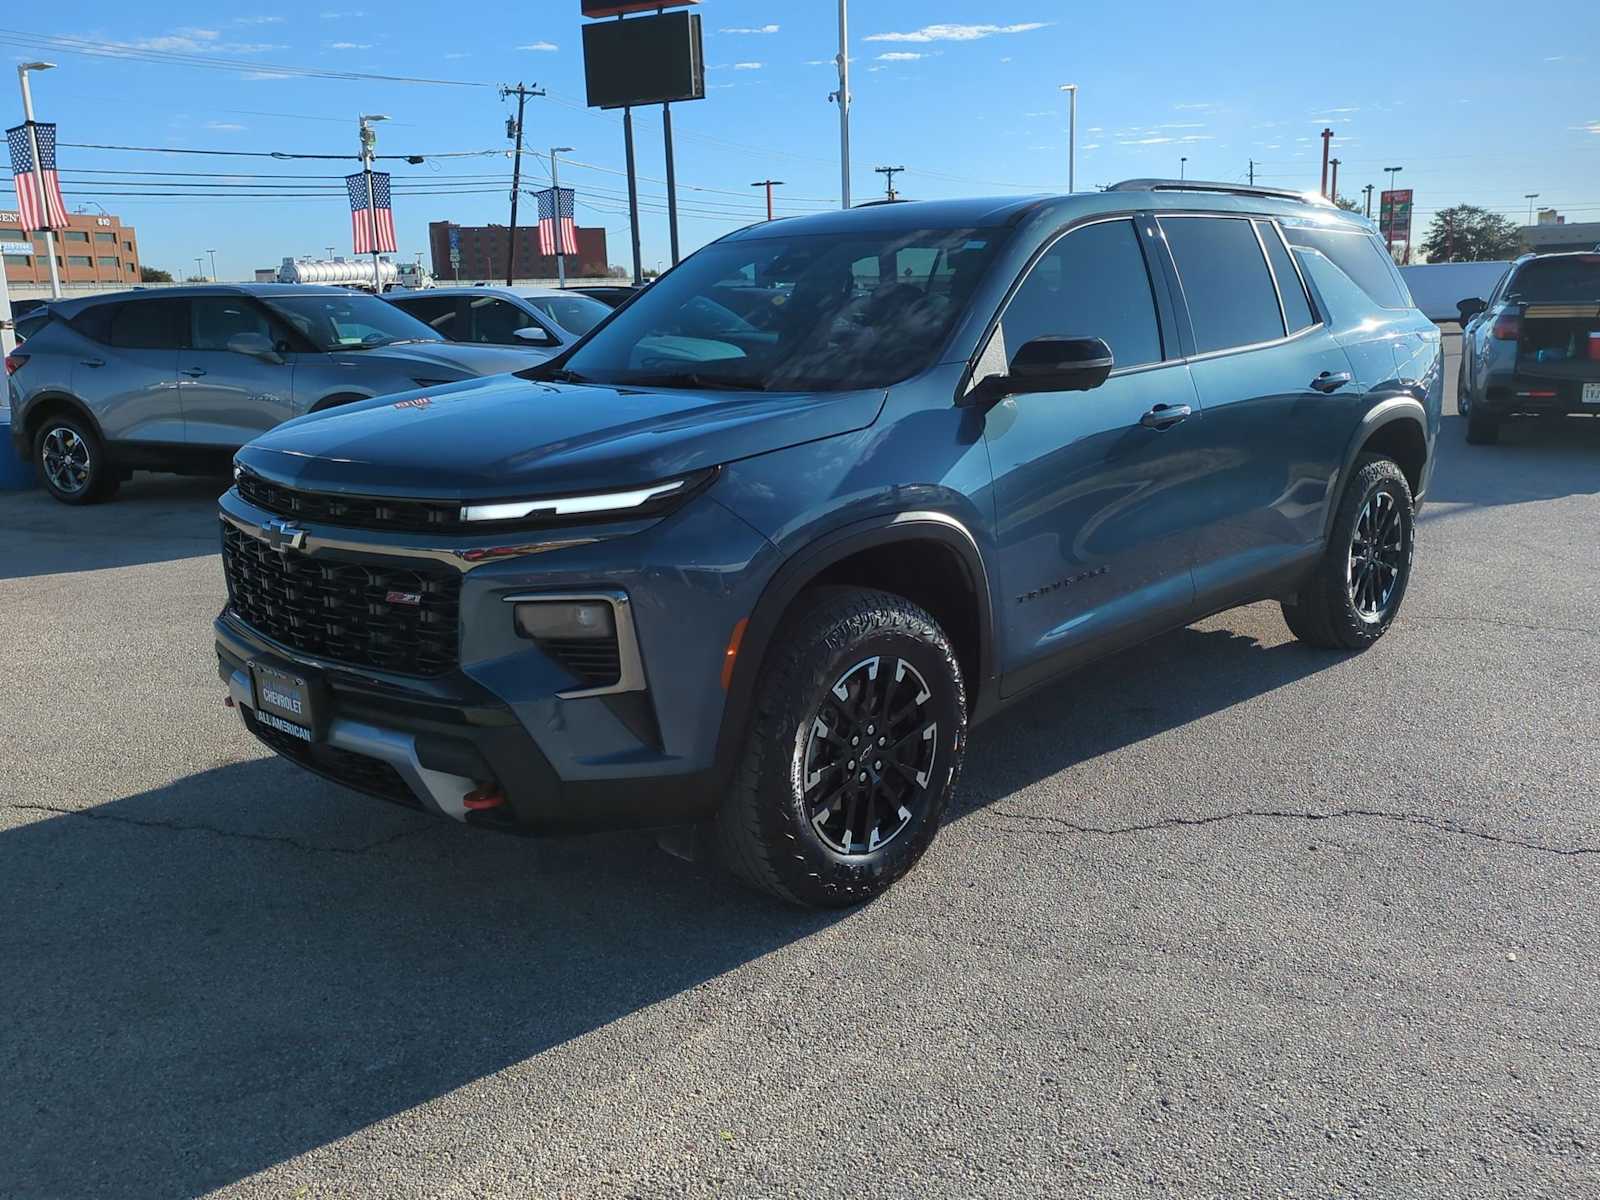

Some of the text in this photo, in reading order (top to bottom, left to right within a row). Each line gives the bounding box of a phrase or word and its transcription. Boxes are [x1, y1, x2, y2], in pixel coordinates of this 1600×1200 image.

[263, 688, 302, 714] CHEVROLET
[258, 710, 312, 741] ALL AMERICAN
